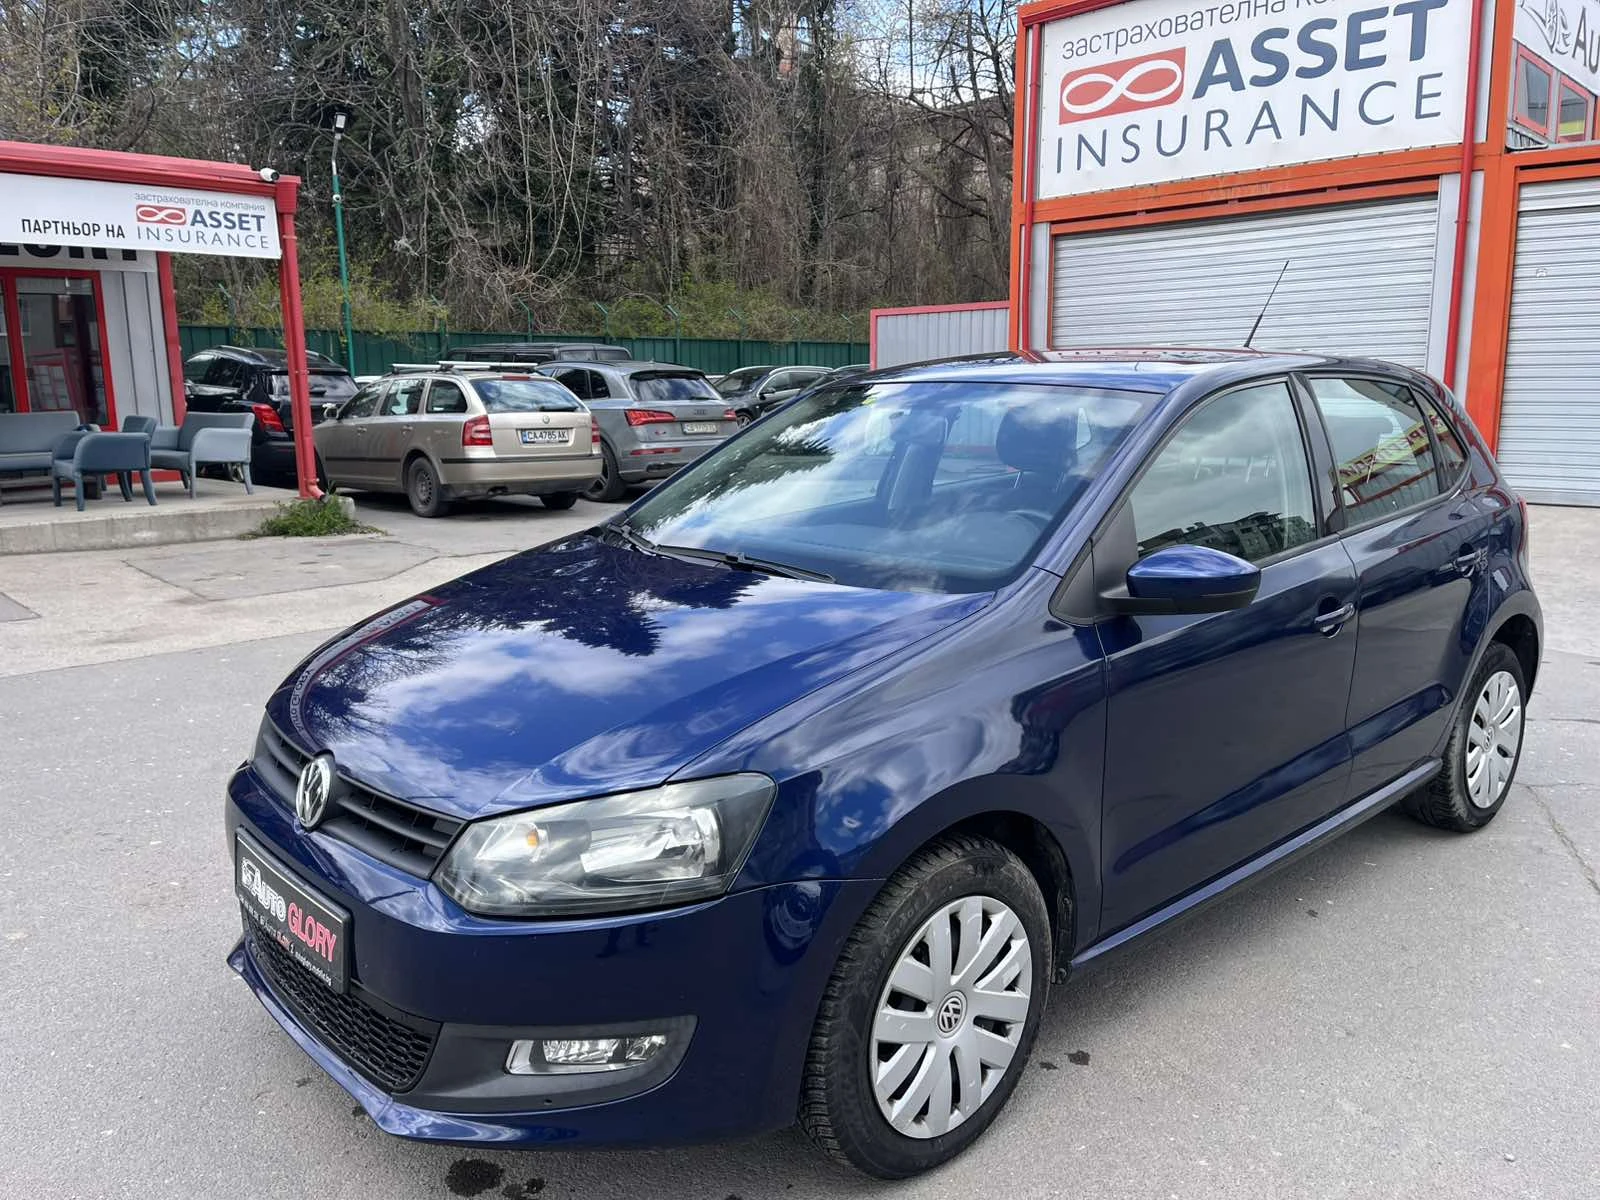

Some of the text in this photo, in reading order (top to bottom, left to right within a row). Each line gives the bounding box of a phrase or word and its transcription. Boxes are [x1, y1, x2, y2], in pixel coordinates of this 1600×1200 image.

[1062, 0, 1287, 60] застрахователна
[1192, 0, 1448, 100] ASSET
[1056, 71, 1444, 174] INSURANCE
[190, 208, 266, 232] ASSET
[220, 201, 266, 212] компания
[22, 218, 126, 239] ПАРТНЬОР НА
[137, 226, 270, 249] INSURANCE
[251, 867, 287, 923] AUTO
[287, 902, 337, 963] GLORY
